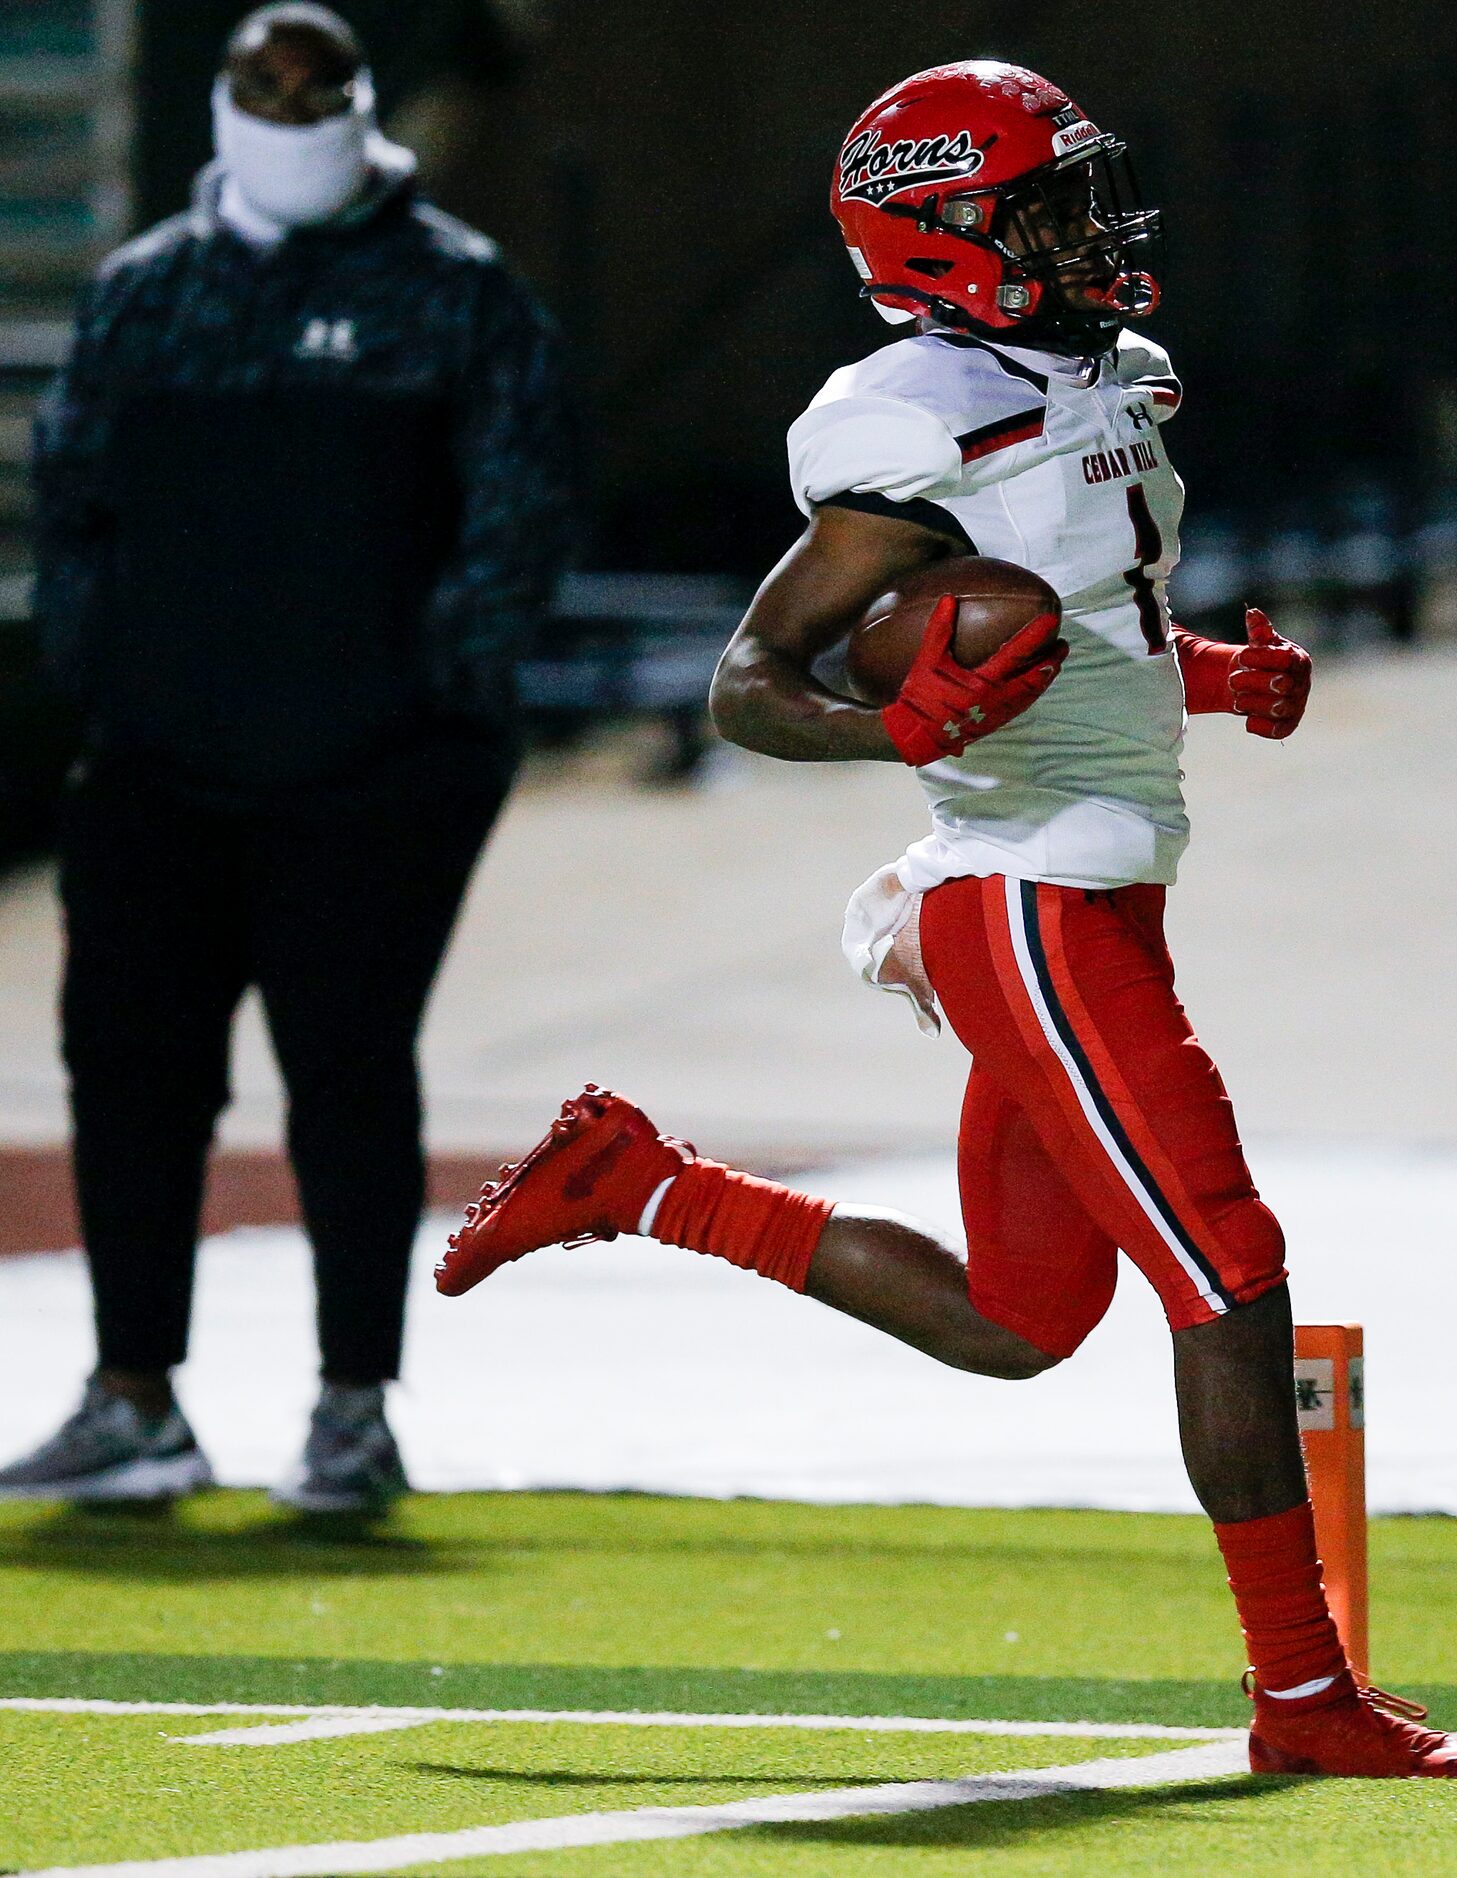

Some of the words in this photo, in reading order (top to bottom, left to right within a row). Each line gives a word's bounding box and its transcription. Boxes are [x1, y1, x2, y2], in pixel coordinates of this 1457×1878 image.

[839, 130, 974, 193] Horns
[1081, 447, 1132, 485] CEDAR
[1129, 440, 1158, 473] HILL
[1122, 482, 1167, 656] 1
